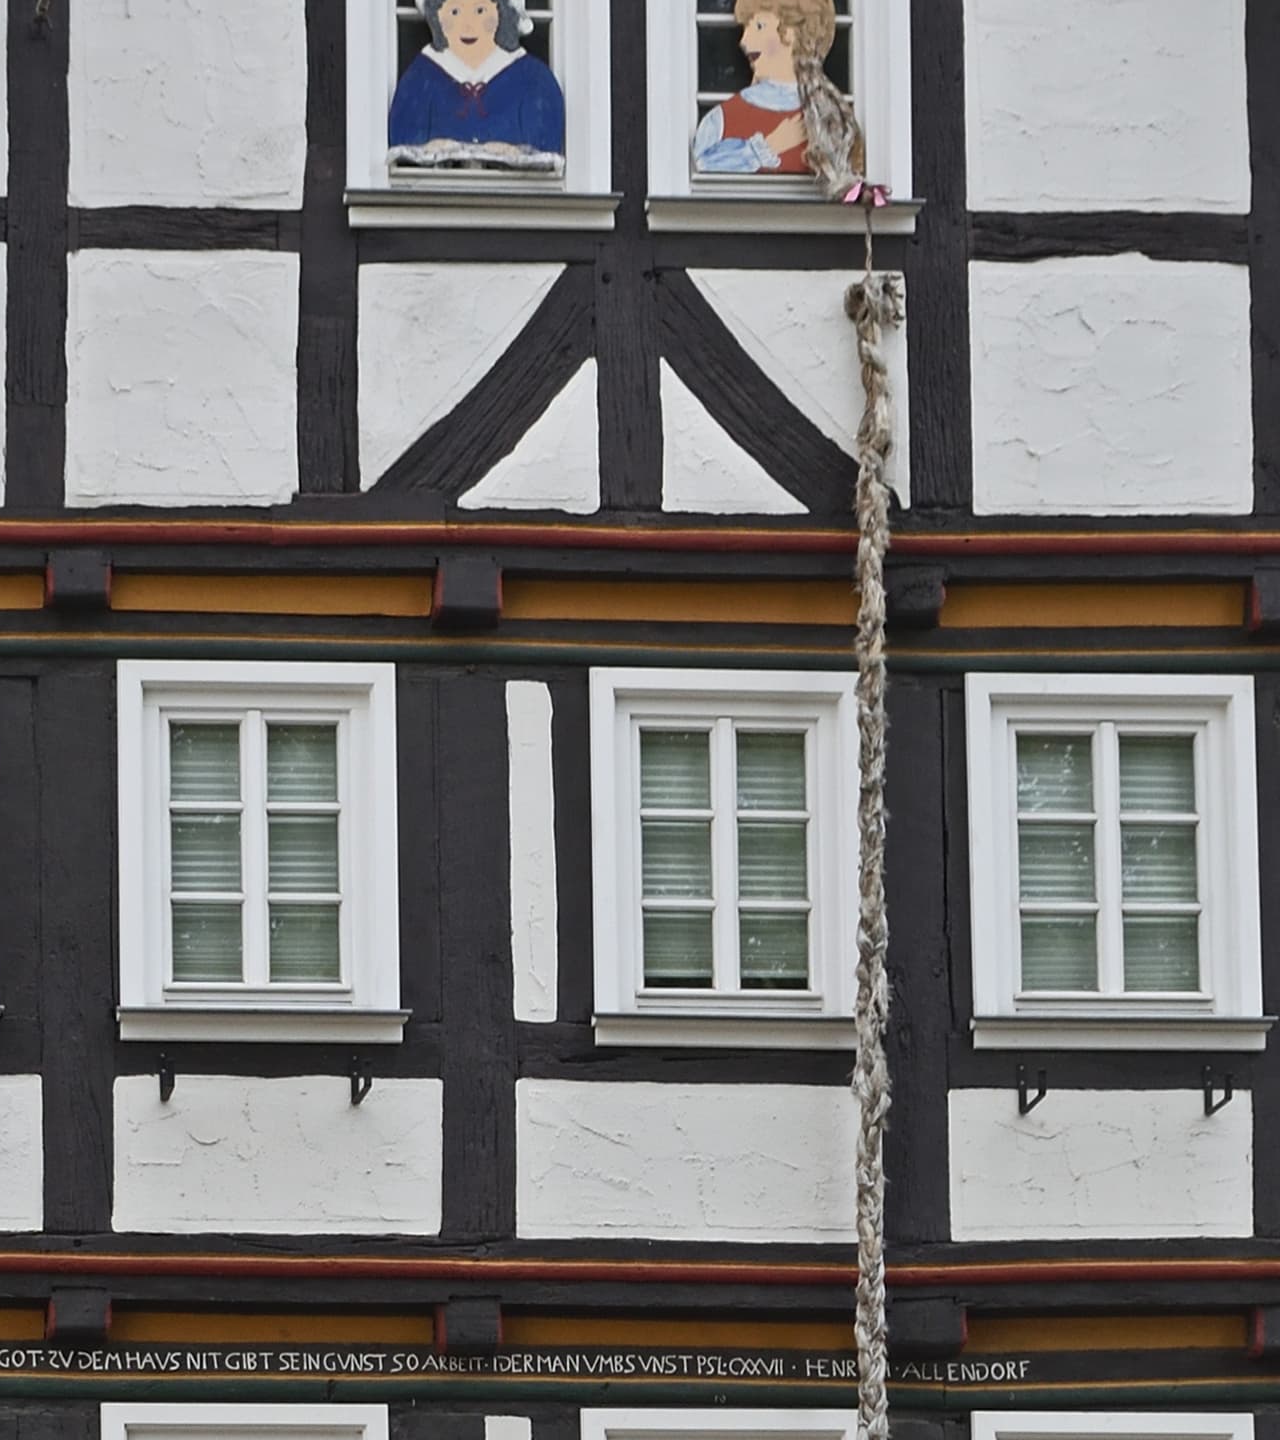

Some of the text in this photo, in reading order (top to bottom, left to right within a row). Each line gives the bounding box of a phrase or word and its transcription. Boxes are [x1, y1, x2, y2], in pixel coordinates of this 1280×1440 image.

[78, 1351, 121, 1370] DEM
[126, 1351, 181, 1371] HAVS
[186, 1352, 221, 1370] NIT
[225, 1352, 274, 1371] GIBT
[279, 1352, 320, 1371] SEIN
[323, 1353, 387, 1372] GVNST
[390, 1353, 419, 1373] SO
[901, 1360, 1031, 1381] ALLENDORF
